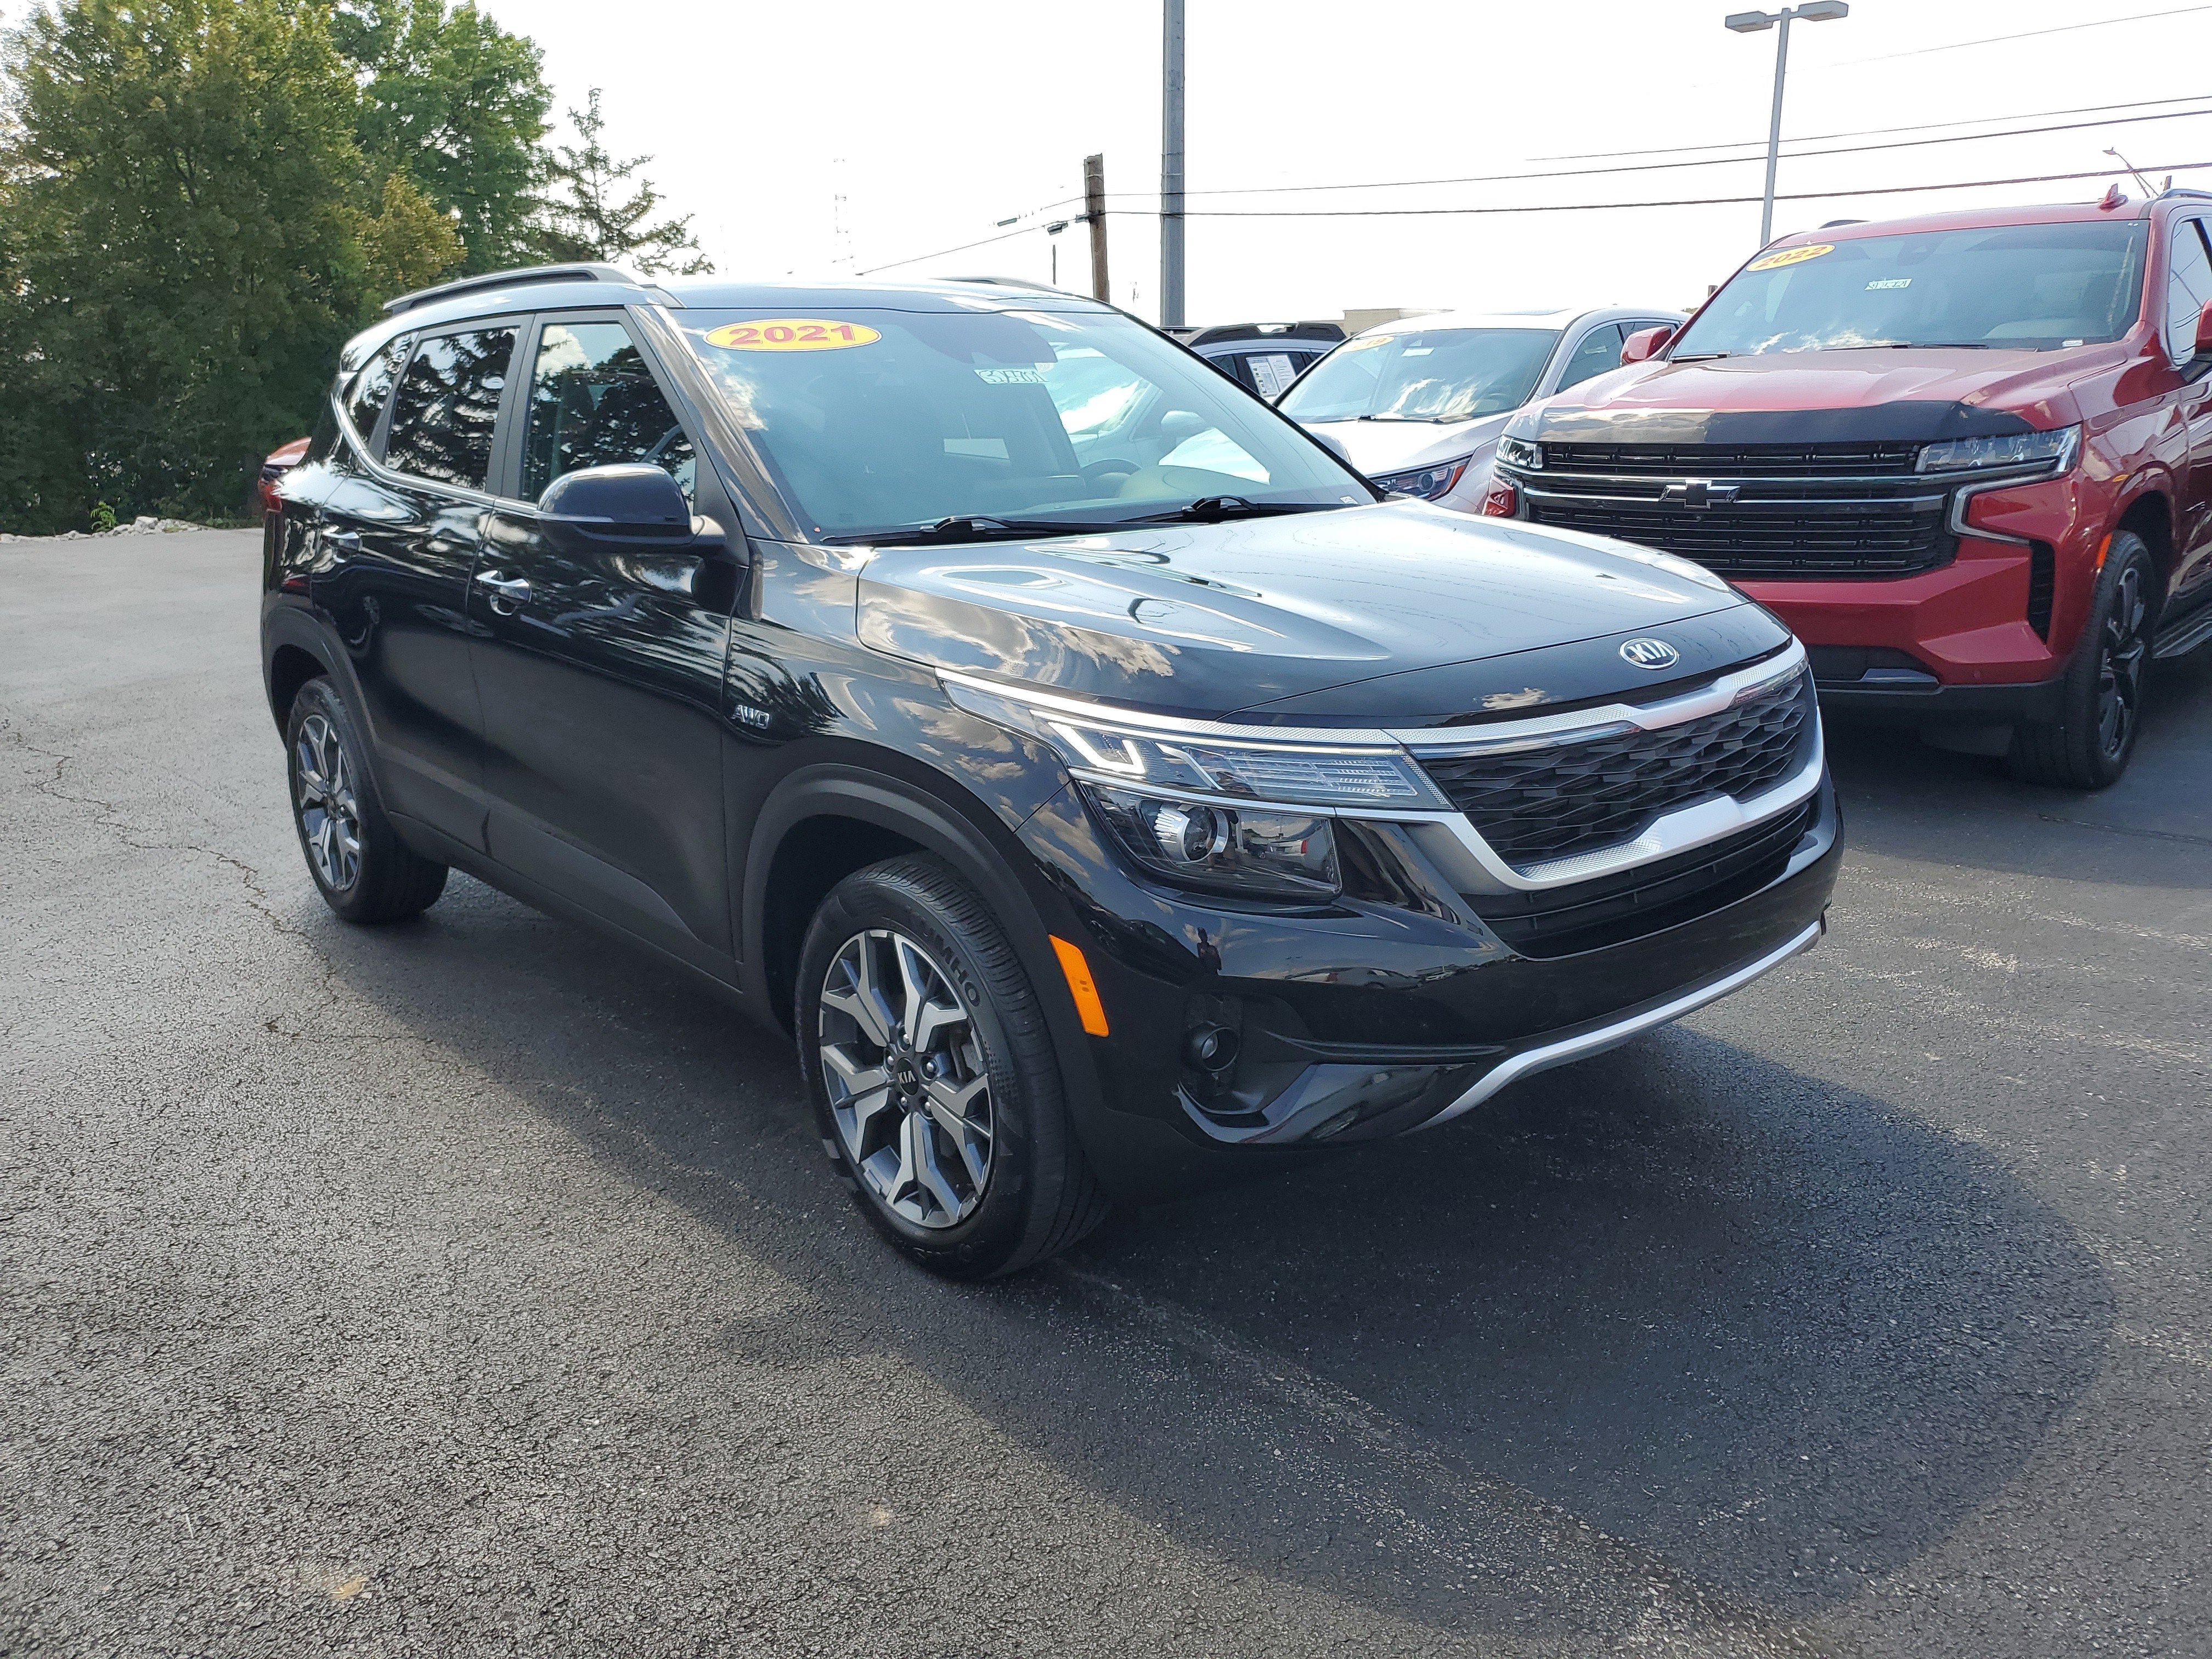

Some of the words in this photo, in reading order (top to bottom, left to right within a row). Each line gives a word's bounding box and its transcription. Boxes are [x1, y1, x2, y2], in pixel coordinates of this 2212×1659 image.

[1754, 246, 1828, 269] 2022
[729, 325, 856, 346] 2021
[1626, 640, 1674, 662] KIA
[730, 704, 770, 730] AWD
[898, 1070, 917, 1084] KIA
